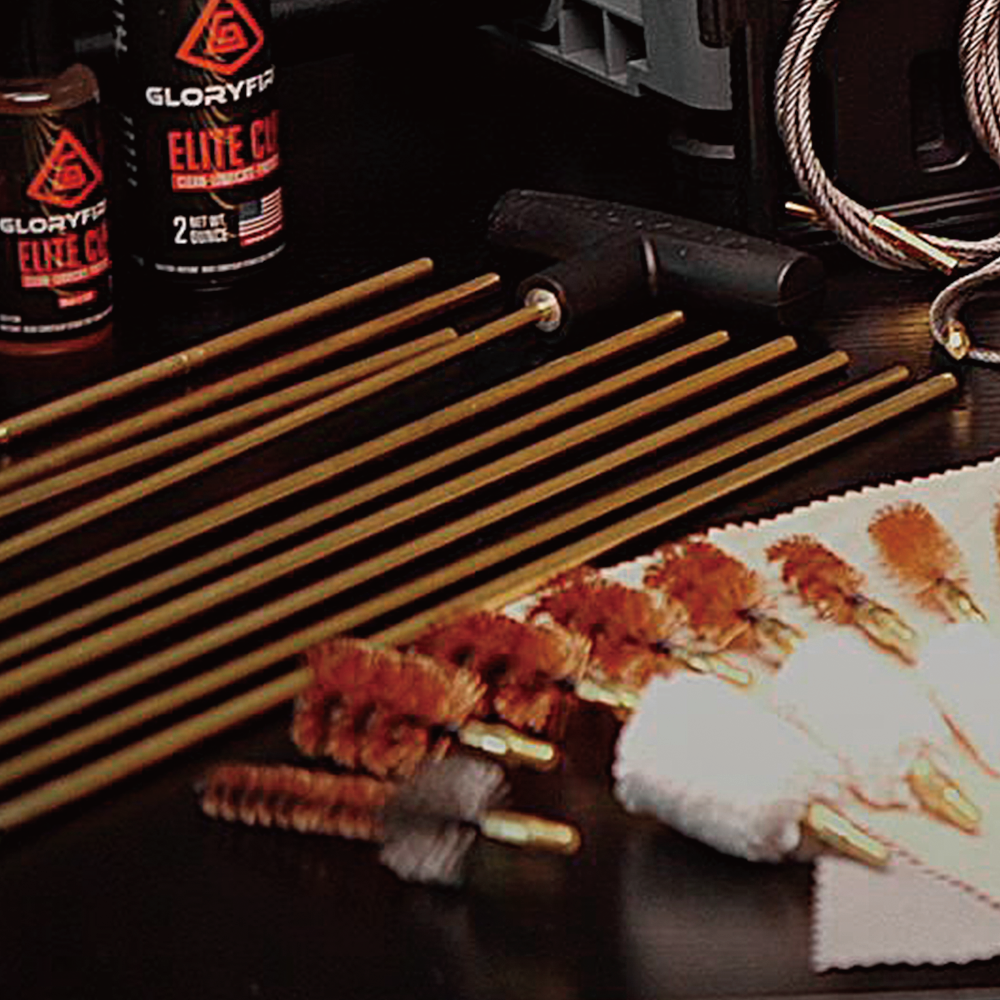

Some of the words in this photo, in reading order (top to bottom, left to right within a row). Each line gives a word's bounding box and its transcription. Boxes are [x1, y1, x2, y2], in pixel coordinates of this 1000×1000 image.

[166, 124, 245, 171] ELITE
[172, 215, 188, 244] 2
[18, 233, 80, 274] ELITE
